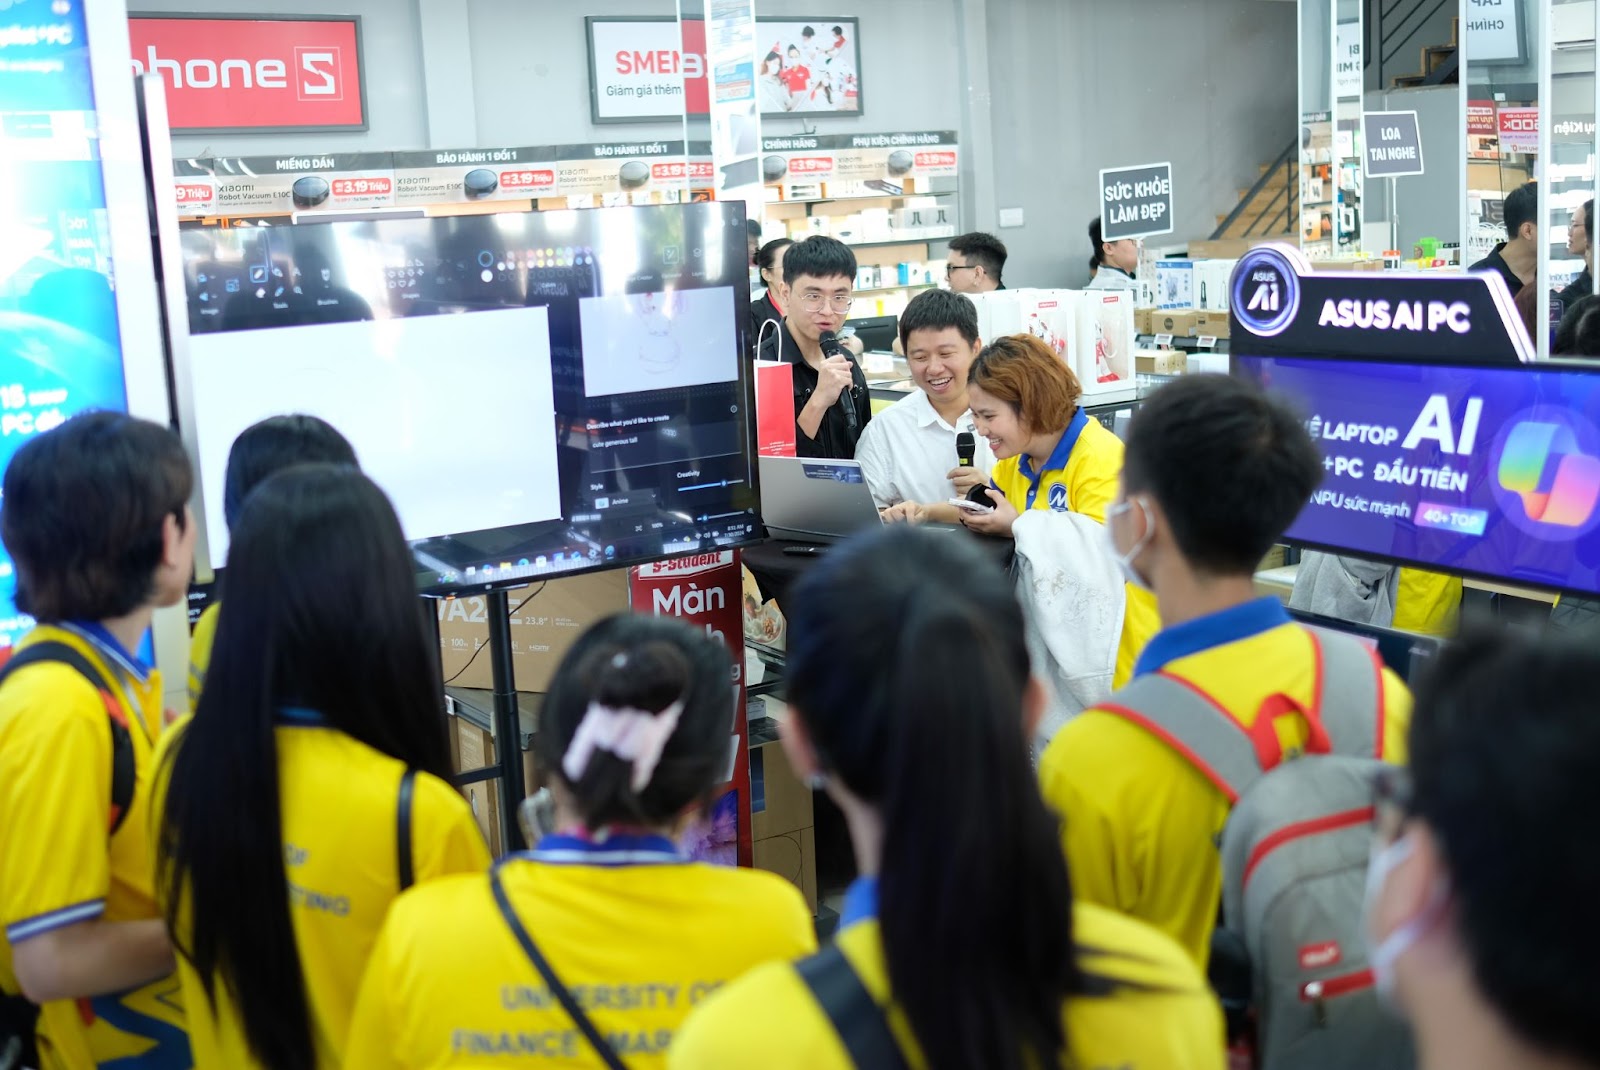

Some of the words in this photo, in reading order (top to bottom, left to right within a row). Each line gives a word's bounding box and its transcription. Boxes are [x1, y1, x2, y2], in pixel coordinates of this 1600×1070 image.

[636, 79, 652, 98] giá
[1381, 127, 1401, 140] LOA
[764, 138, 792, 149] CHÍNH
[436, 153, 456, 164] BẢO
[458, 152, 486, 163] HÀNH
[487, 152, 492, 161] 1
[493, 149, 511, 161] ĐỔI
[512, 151, 517, 160] 1
[1370, 148, 1386, 161] TAI
[1388, 146, 1416, 160] NGHE
[276, 157, 310, 171] MIẾNG
[312, 157, 335, 169] DÁN
[511, 173, 532, 185] 3.19
[344, 180, 367, 194] 3.19
[368, 181, 389, 193] Triệu
[1105, 181, 1132, 202] SỨC
[1134, 175, 1169, 198] KHỎE
[186, 189, 209, 200] Triệu
[219, 193, 240, 201] Robot
[1109, 204, 1138, 224] LÀM
[1140, 202, 1166, 222] ĐẸP
[1252, 271, 1276, 282] ASUS
[1318, 298, 1391, 330] ASUS
[1391, 300, 1423, 332] AI
[1427, 300, 1472, 334] PC
[586, 421, 609, 430] Describe
[609, 420, 622, 428] what
[623, 418, 637, 427] you'd
[1322, 420, 1399, 446] LAPTOP
[1400, 394, 1484, 456] AI
[605, 438, 628, 448] generous
[676, 470, 700, 478] Creativity
[1419, 464, 1469, 493] TIÊN
[590, 483, 604, 491] Style
[1344, 495, 1369, 512] sức
[1369, 502, 1412, 519] mạnh
[652, 552, 721, 574] S-Student
[652, 583, 725, 619] Màn
